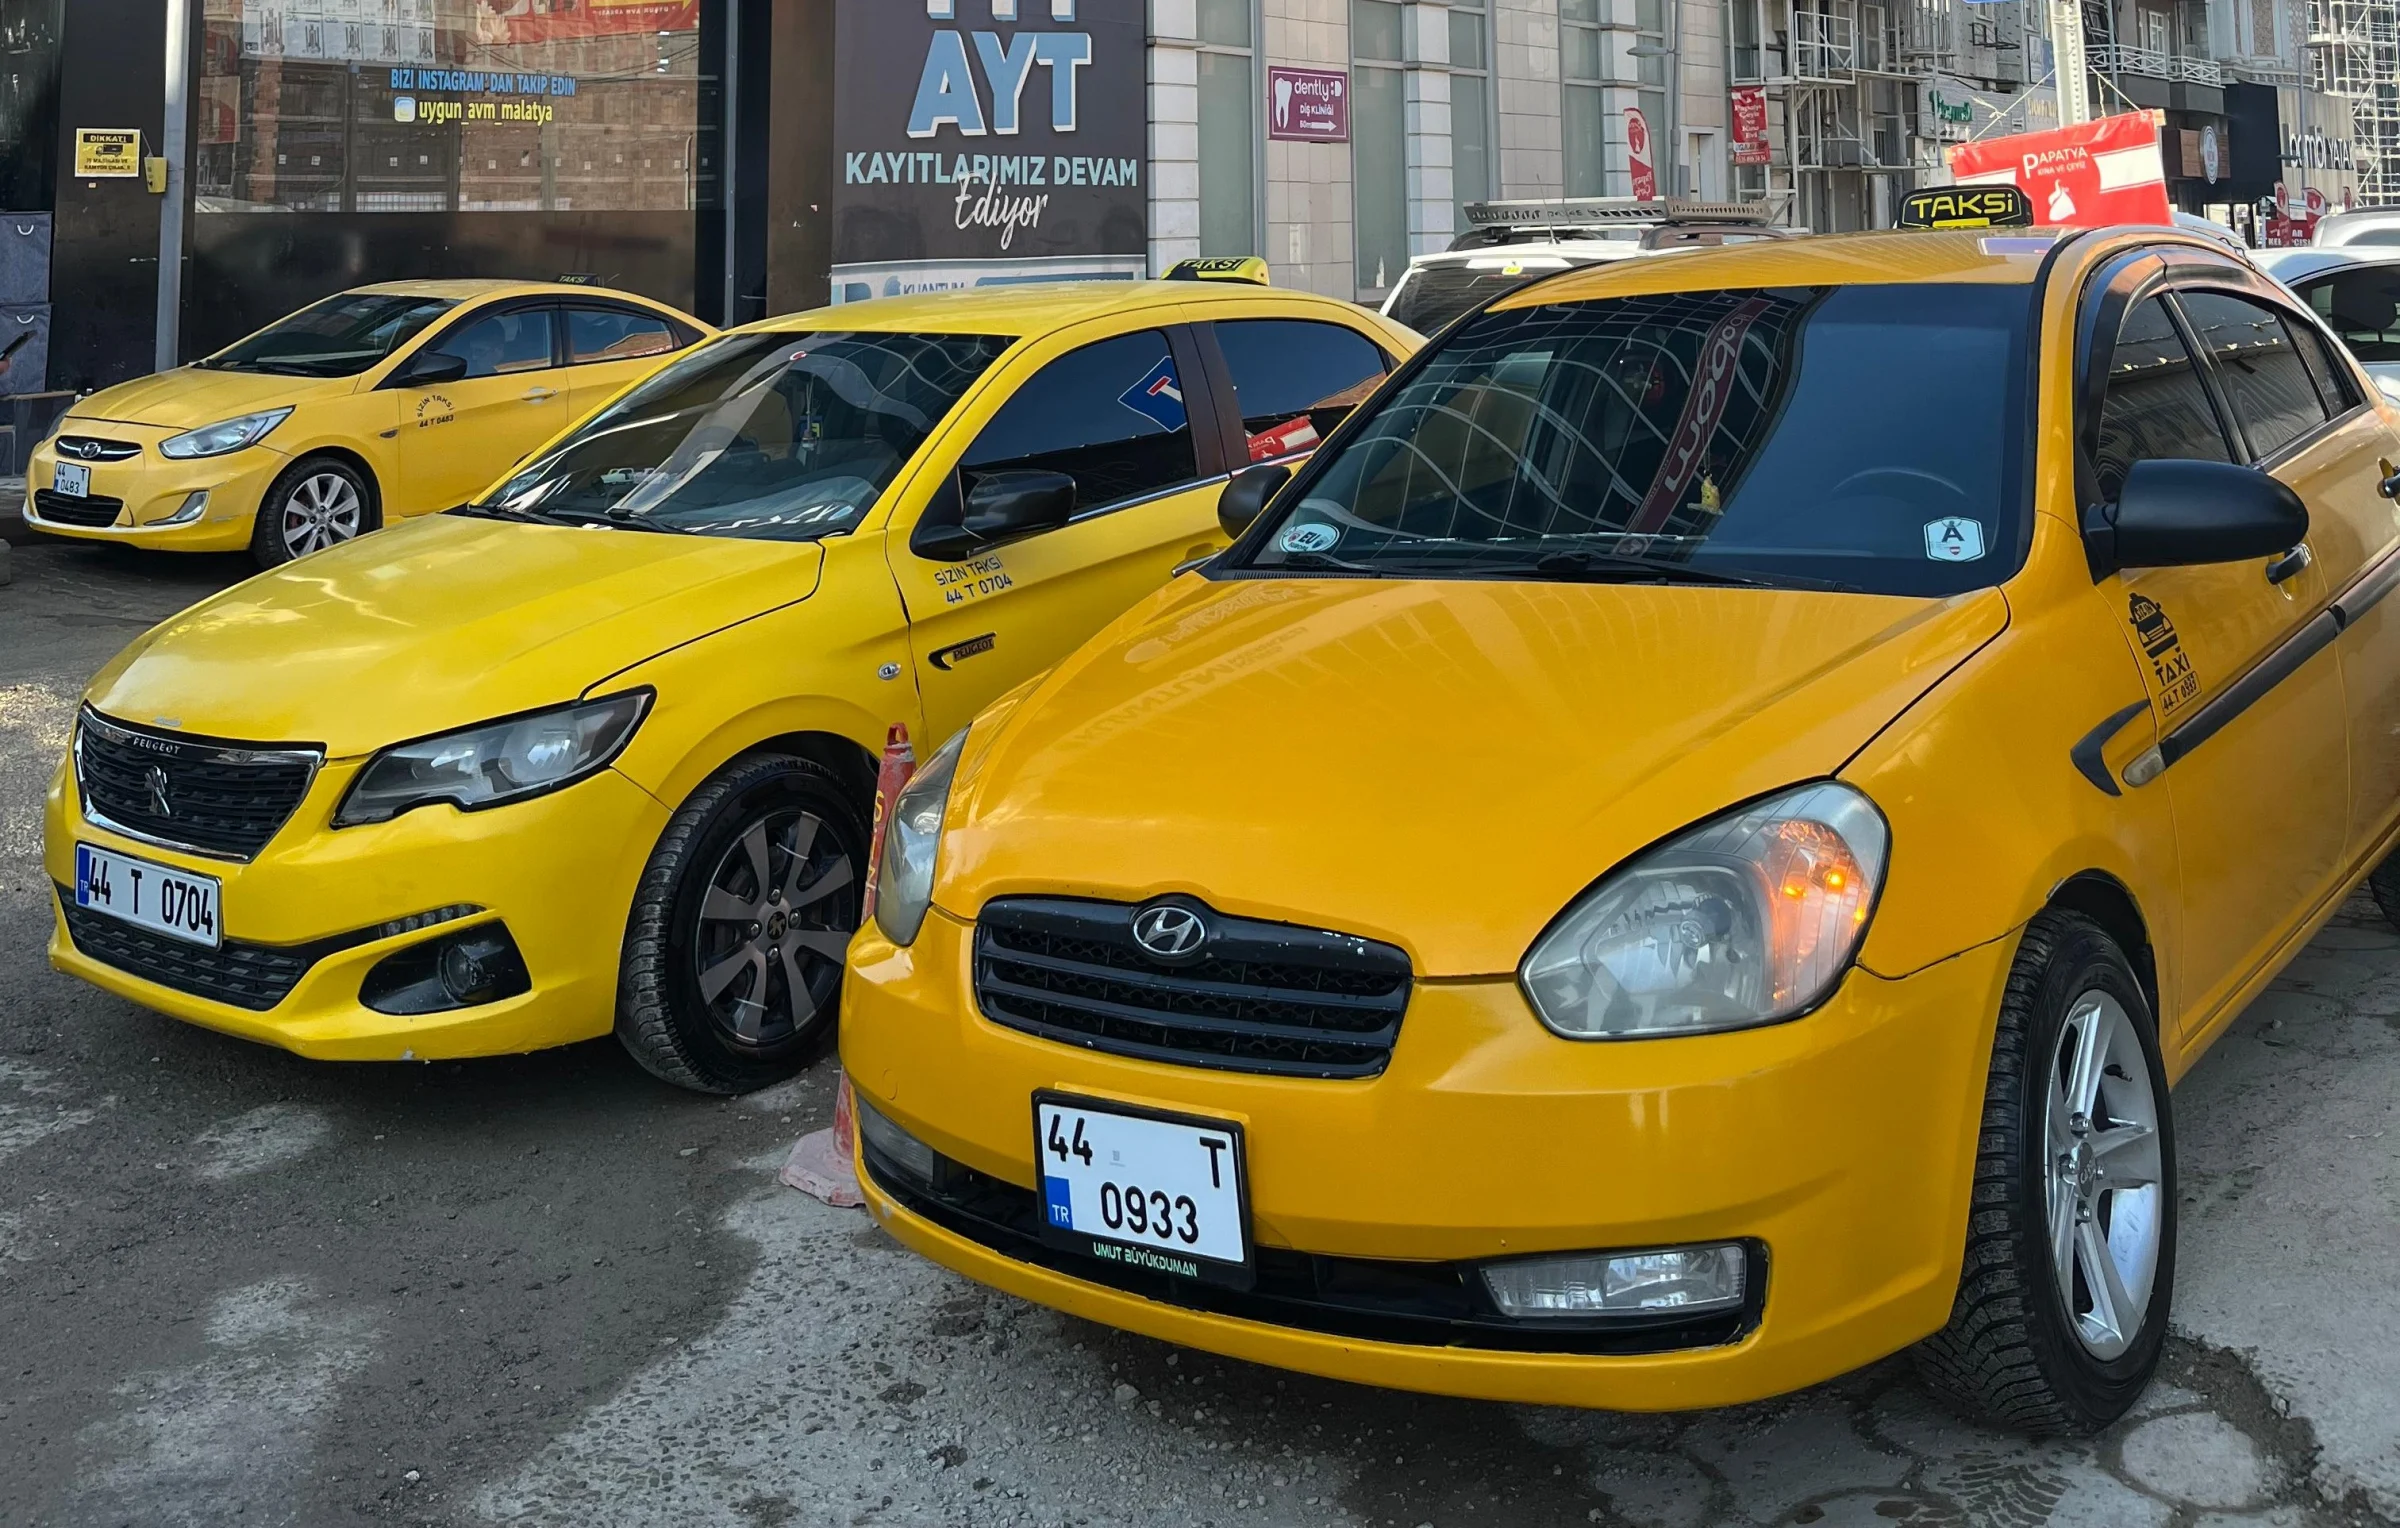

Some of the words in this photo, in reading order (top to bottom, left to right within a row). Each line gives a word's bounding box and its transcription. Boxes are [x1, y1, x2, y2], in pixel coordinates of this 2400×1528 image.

[551, 71, 576, 96] EDİN
[906, 29, 1092, 138] AYT
[418, 99, 553, 126] uygun_avm_malatya
[845, 151, 1046, 187] KAYITLARIMIZ
[1054, 156, 1138, 187] DEVAM
[2022, 147, 2088, 179] PAPATYA
[954, 172, 1049, 250] Ediyor
[430, 417, 436, 425] T
[57, 464, 66, 478] 44
[80, 468, 87, 482] T
[60, 478, 81, 495] 0483
[1297, 530, 1322, 545] EU
[1941, 525, 1966, 543] A
[945, 587, 964, 605] 44
[963, 583, 976, 598] T
[978, 572, 1014, 595] 0704
[953, 636, 995, 662] PEUGEOT
[2155, 651, 2192, 687] TAXI
[2163, 693, 2175, 711] 44
[2172, 688, 2181, 704] T
[132, 736, 181, 755] PEUGEOT
[79, 878, 89, 894] TR
[88, 857, 112, 905] 44
[130, 868, 143, 915] T
[161, 877, 214, 936] 0704
[1048, 1113, 1093, 1167] 44
[1199, 1135, 1227, 1189] T
[1051, 1204, 1070, 1224] TR
[1100, 1180, 1200, 1244] 0933
[1093, 1241, 1123, 1262] UMUT
[1124, 1246, 1198, 1278] BÜYÜKDUMAN
